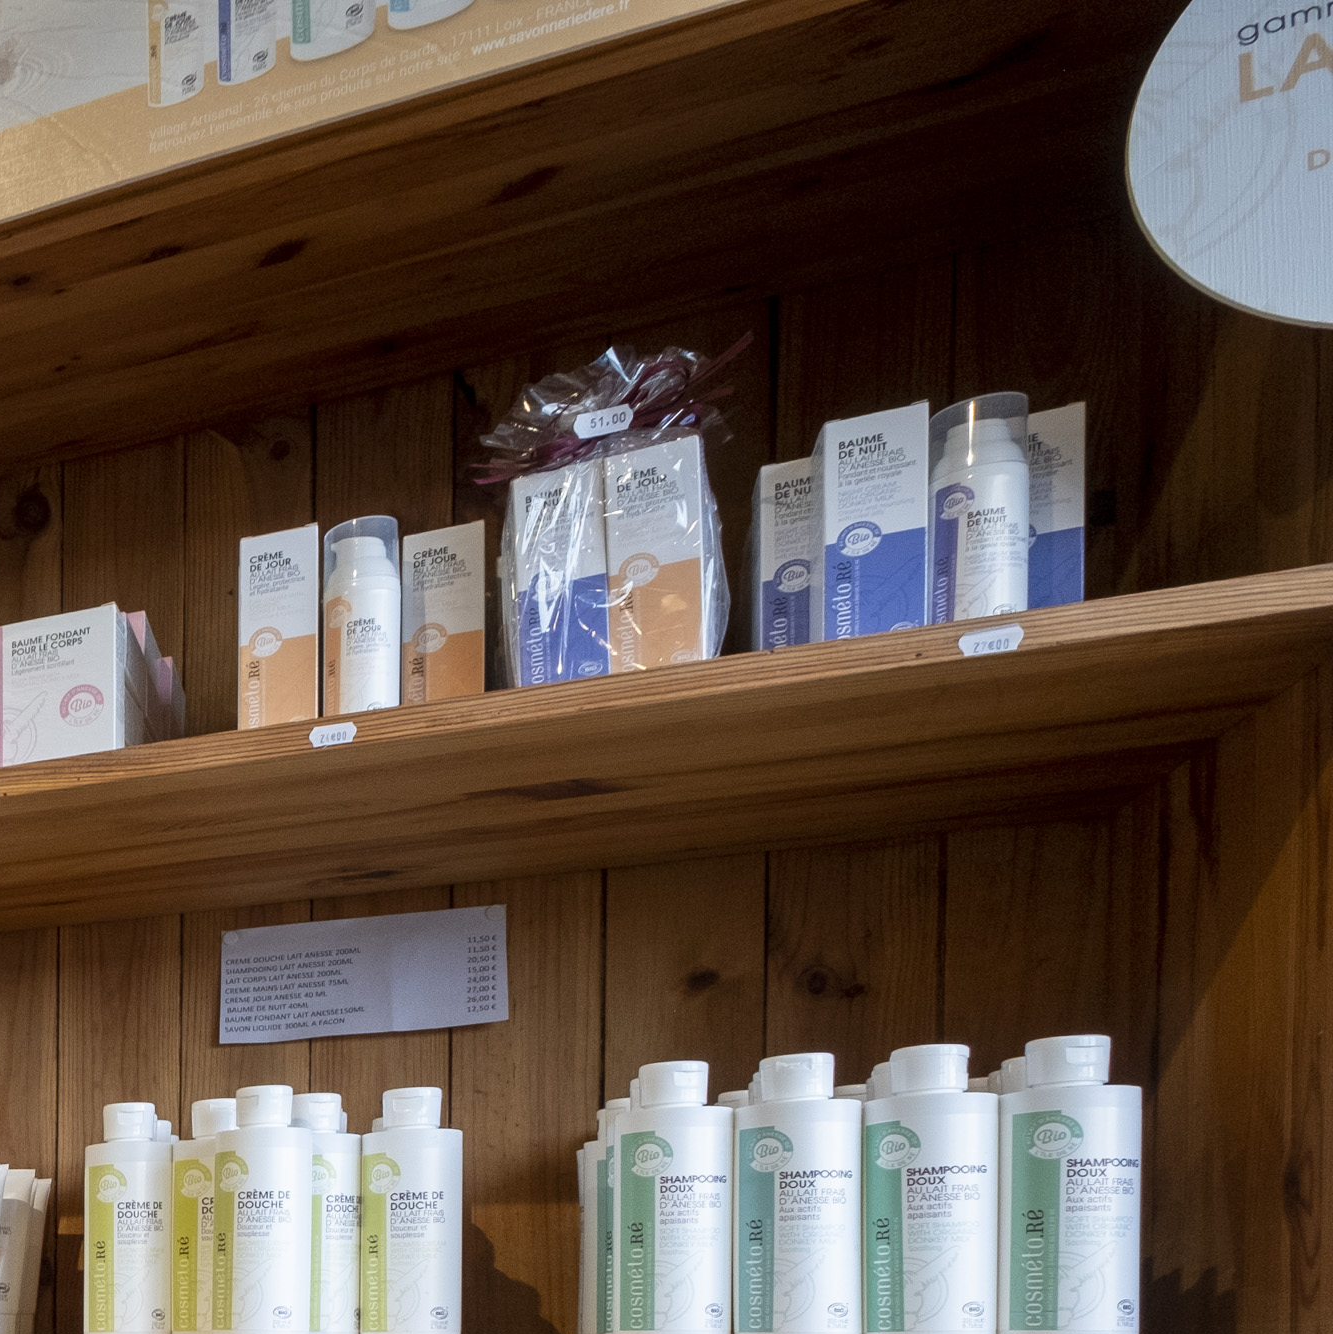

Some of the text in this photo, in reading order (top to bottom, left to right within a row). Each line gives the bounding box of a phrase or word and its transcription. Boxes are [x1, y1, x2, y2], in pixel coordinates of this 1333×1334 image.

[149, 122, 189, 140] Village
[190, 103, 244, 128] Artisanal
[271, 82, 318, 104] chemin
[380, 54, 396, 71] de
[398, 42, 438, 65] Garde
[319, 80, 373, 107] produits
[589, 411, 627, 429] 51,00
[838, 433, 883, 450] BAUME
[838, 442, 887, 460] DE NUIT
[249, 550, 283, 564] CRÈME
[249, 558, 292, 572] DE JOUR
[11, 626, 91, 649] BAUME FONDANT
[11, 637, 83, 657] POUR LE CORPS
[252, 955, 285, 964] DOUCHE
[286, 953, 303, 961] LAIT
[305, 950, 334, 959] ANESSE
[252, 1023, 283, 1032] LIQUIDE
[906, 1164, 988, 1177] SHAMPOOING
[1065, 1158, 1140, 1169] SHAMPOOING
[1066, 1168, 1107, 1178] DOUX
[907, 1176, 946, 1186] DOUX
[237, 1188, 291, 1200] CRÈME DE
[237, 1200, 284, 1210] DOUCHE
[907, 1210, 952, 1220] apaisants
[1021, 1208, 1045, 1327] cosméto.Ré
